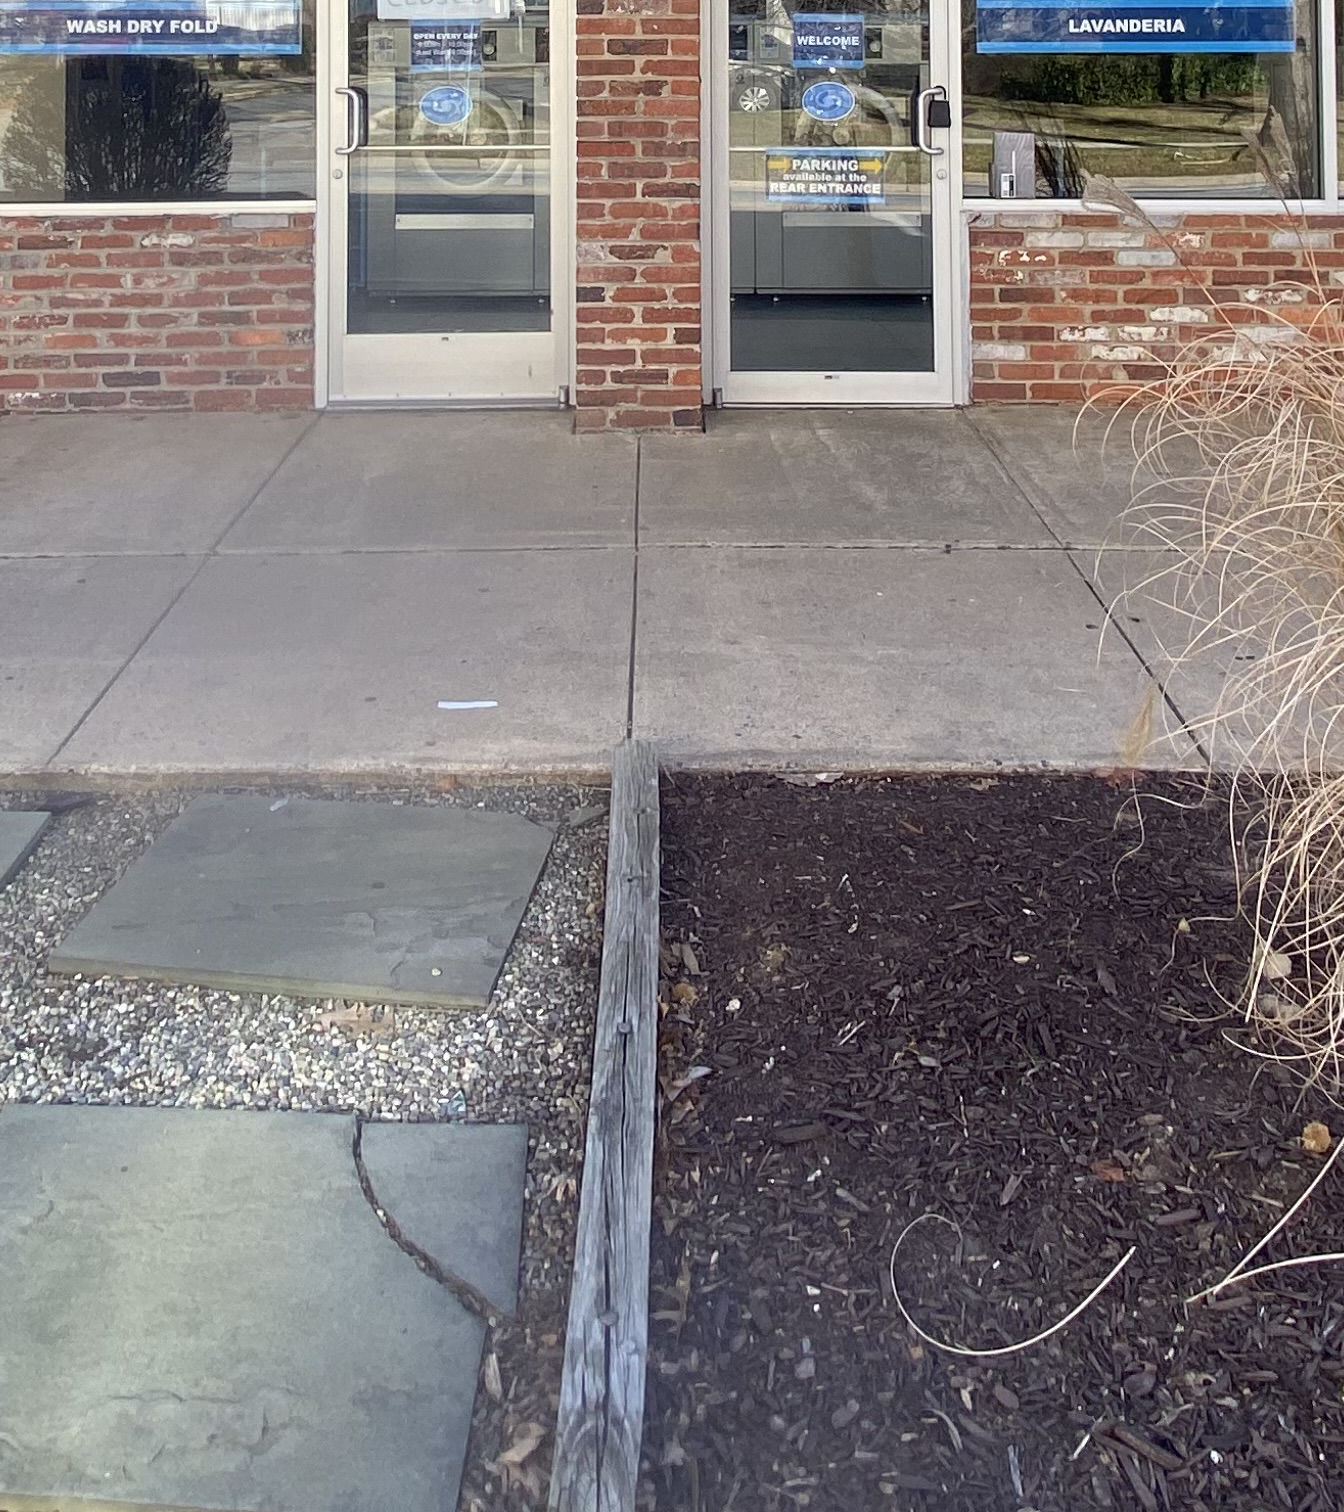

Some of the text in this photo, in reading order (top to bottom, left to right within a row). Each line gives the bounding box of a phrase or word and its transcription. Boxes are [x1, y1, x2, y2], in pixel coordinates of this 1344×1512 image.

[66, 19, 218, 34] WASH DRY FOLD
[1068, 19, 1186, 34] LAVANDERIA
[796, 35, 861, 46] WELCOME
[791, 158, 860, 172] PARKING
[783, 172, 868, 183] available at the
[769, 182, 882, 195] REAR ENTRANCE
